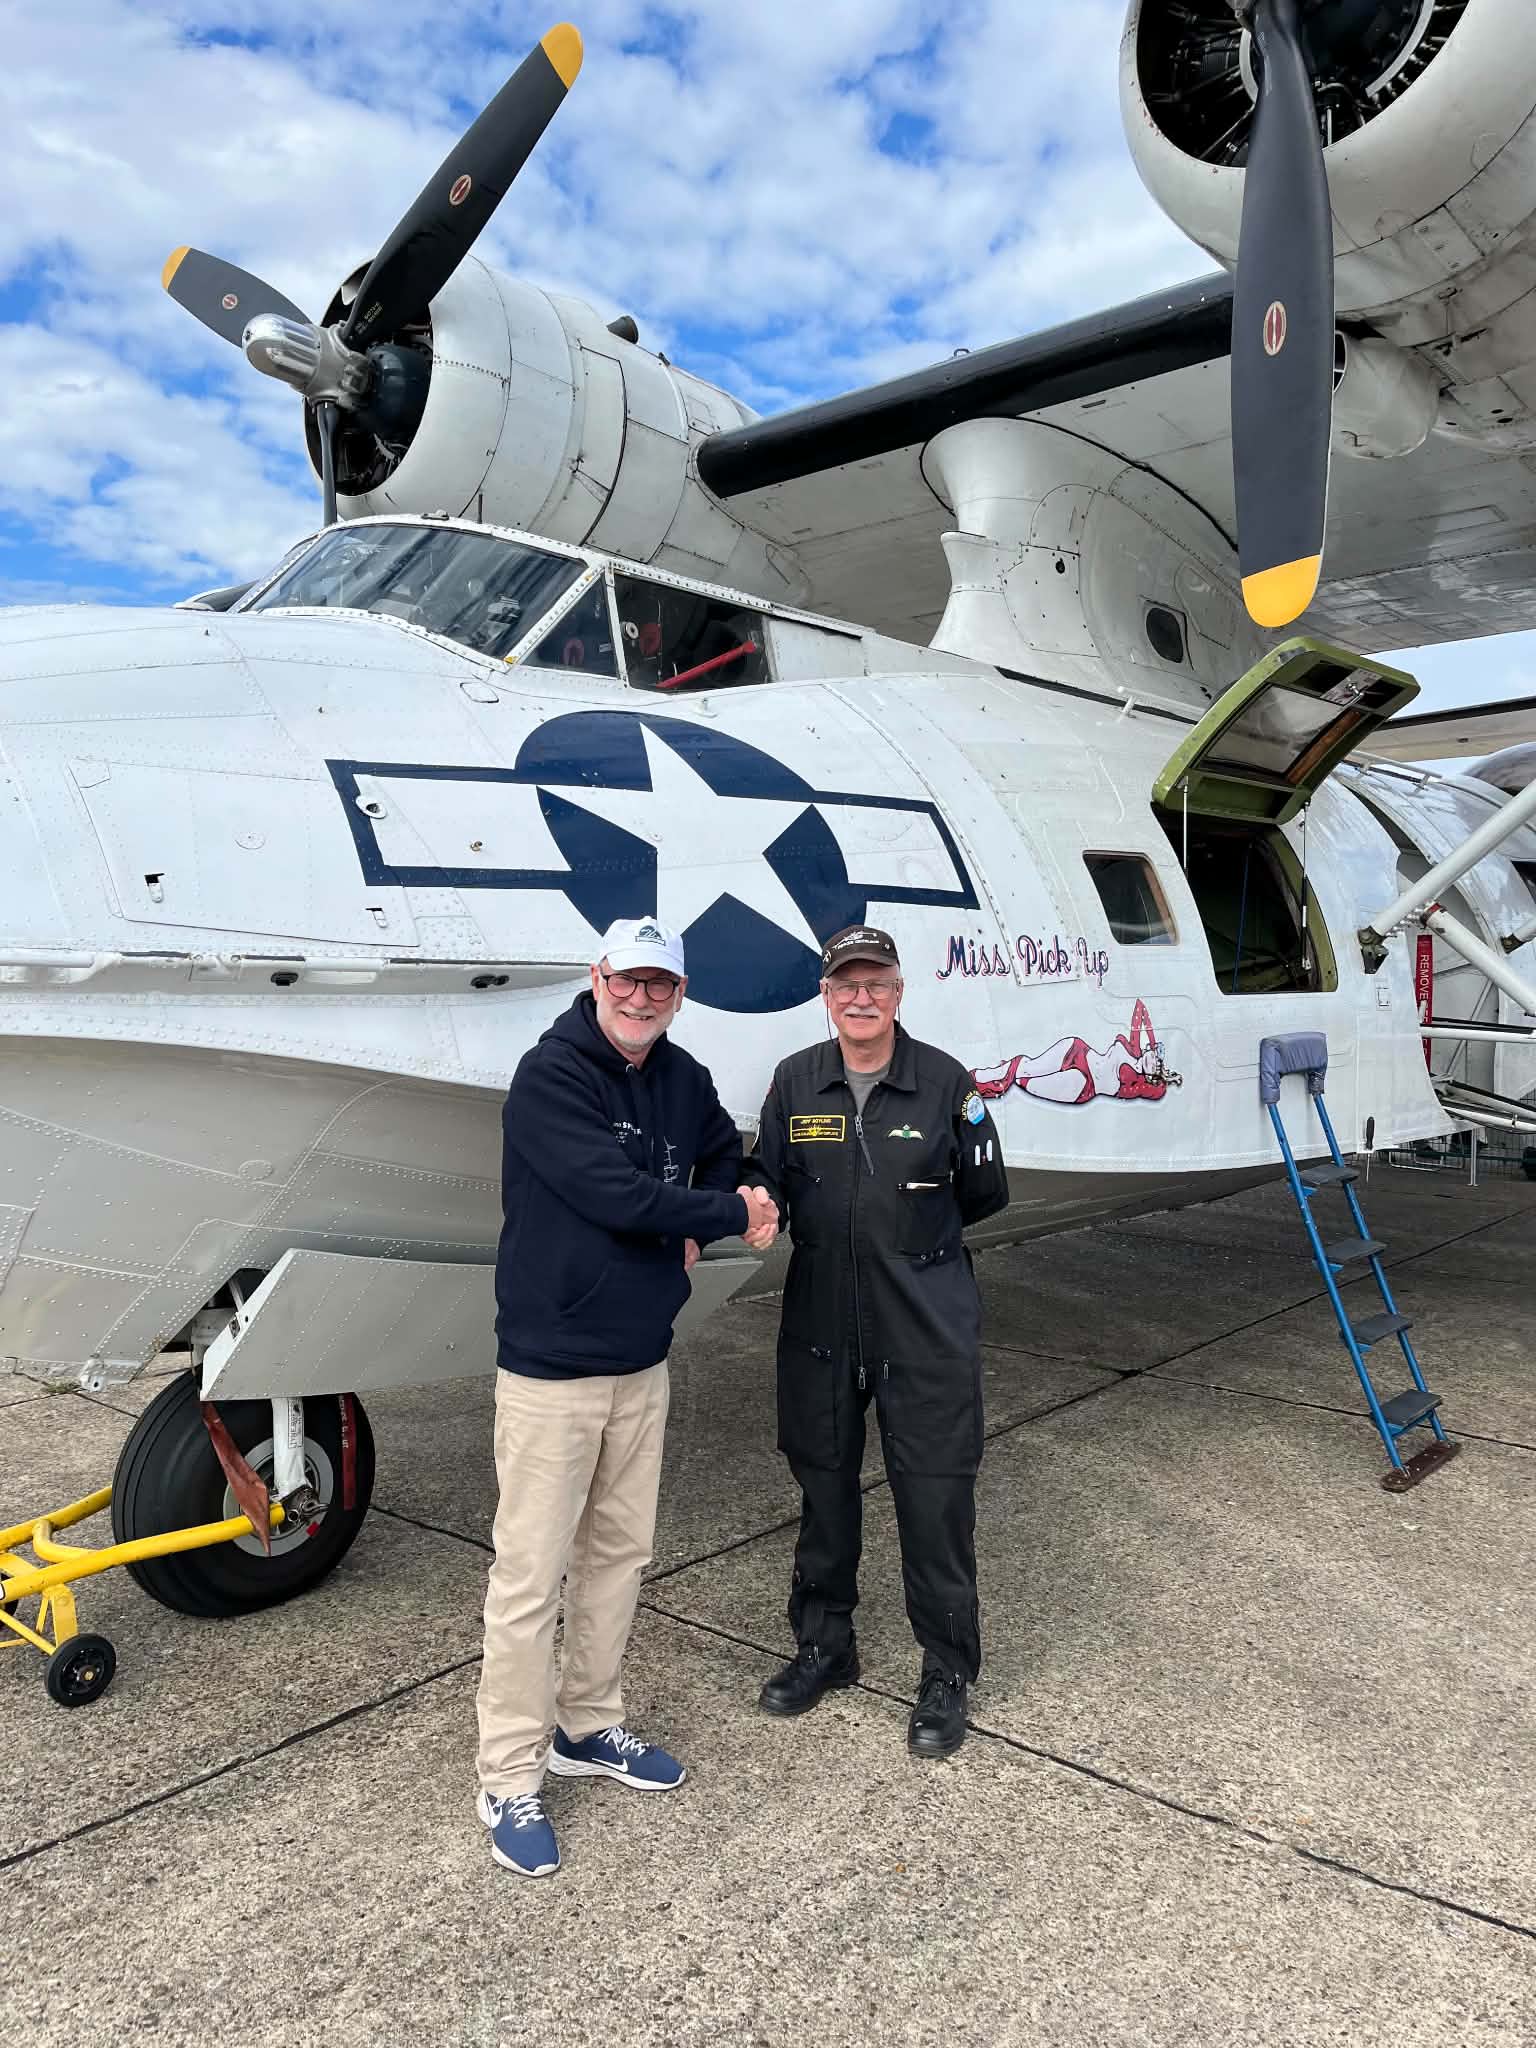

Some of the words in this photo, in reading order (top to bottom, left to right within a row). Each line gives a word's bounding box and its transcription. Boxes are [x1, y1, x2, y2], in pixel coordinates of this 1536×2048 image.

[936, 935, 1011, 980] Miss
[1016, 934, 1072, 977] Pick
[1075, 936, 1110, 991] Up
[1419, 954, 1429, 1000] REMOVE
